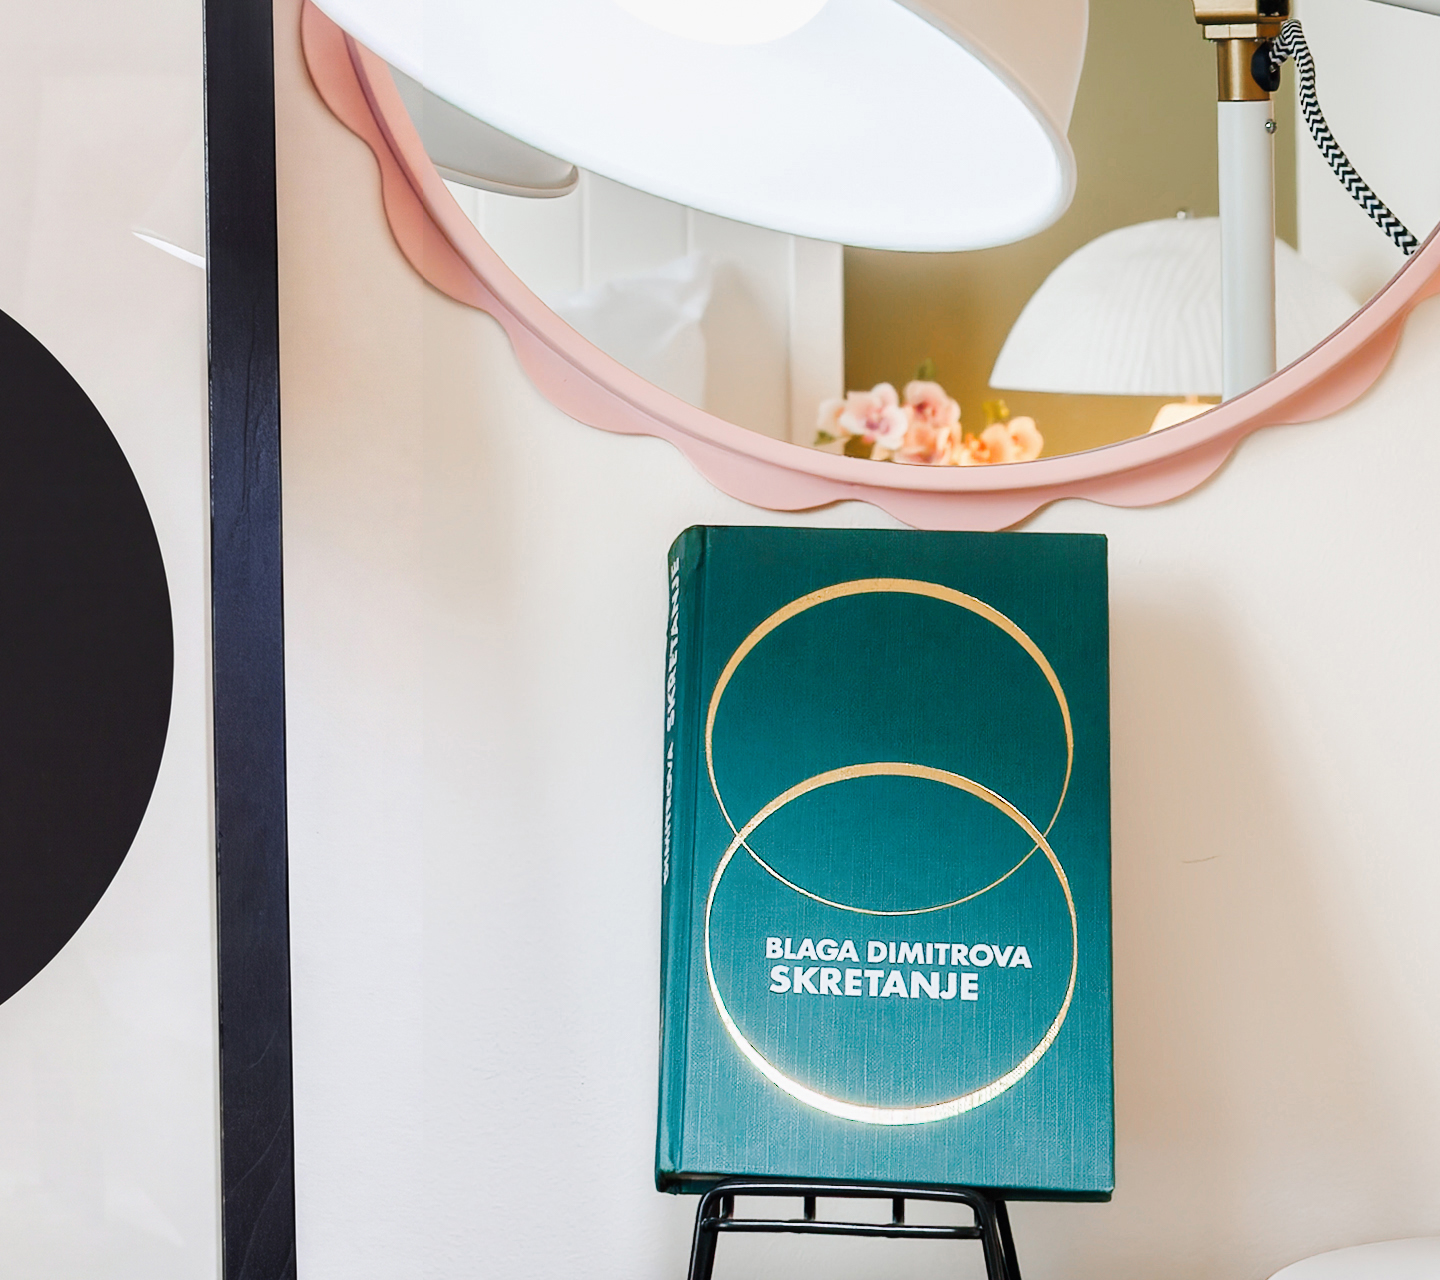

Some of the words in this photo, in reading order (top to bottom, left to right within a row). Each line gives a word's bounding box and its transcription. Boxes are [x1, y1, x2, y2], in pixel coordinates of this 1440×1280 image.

[666, 556, 680, 733] SKRETANJE
[663, 740, 674, 886] DIMITROVA
[765, 936, 860, 963] BLAGA
[866, 940, 1033, 969] DIMITROVA
[769, 965, 979, 1001] SKRETANJE
